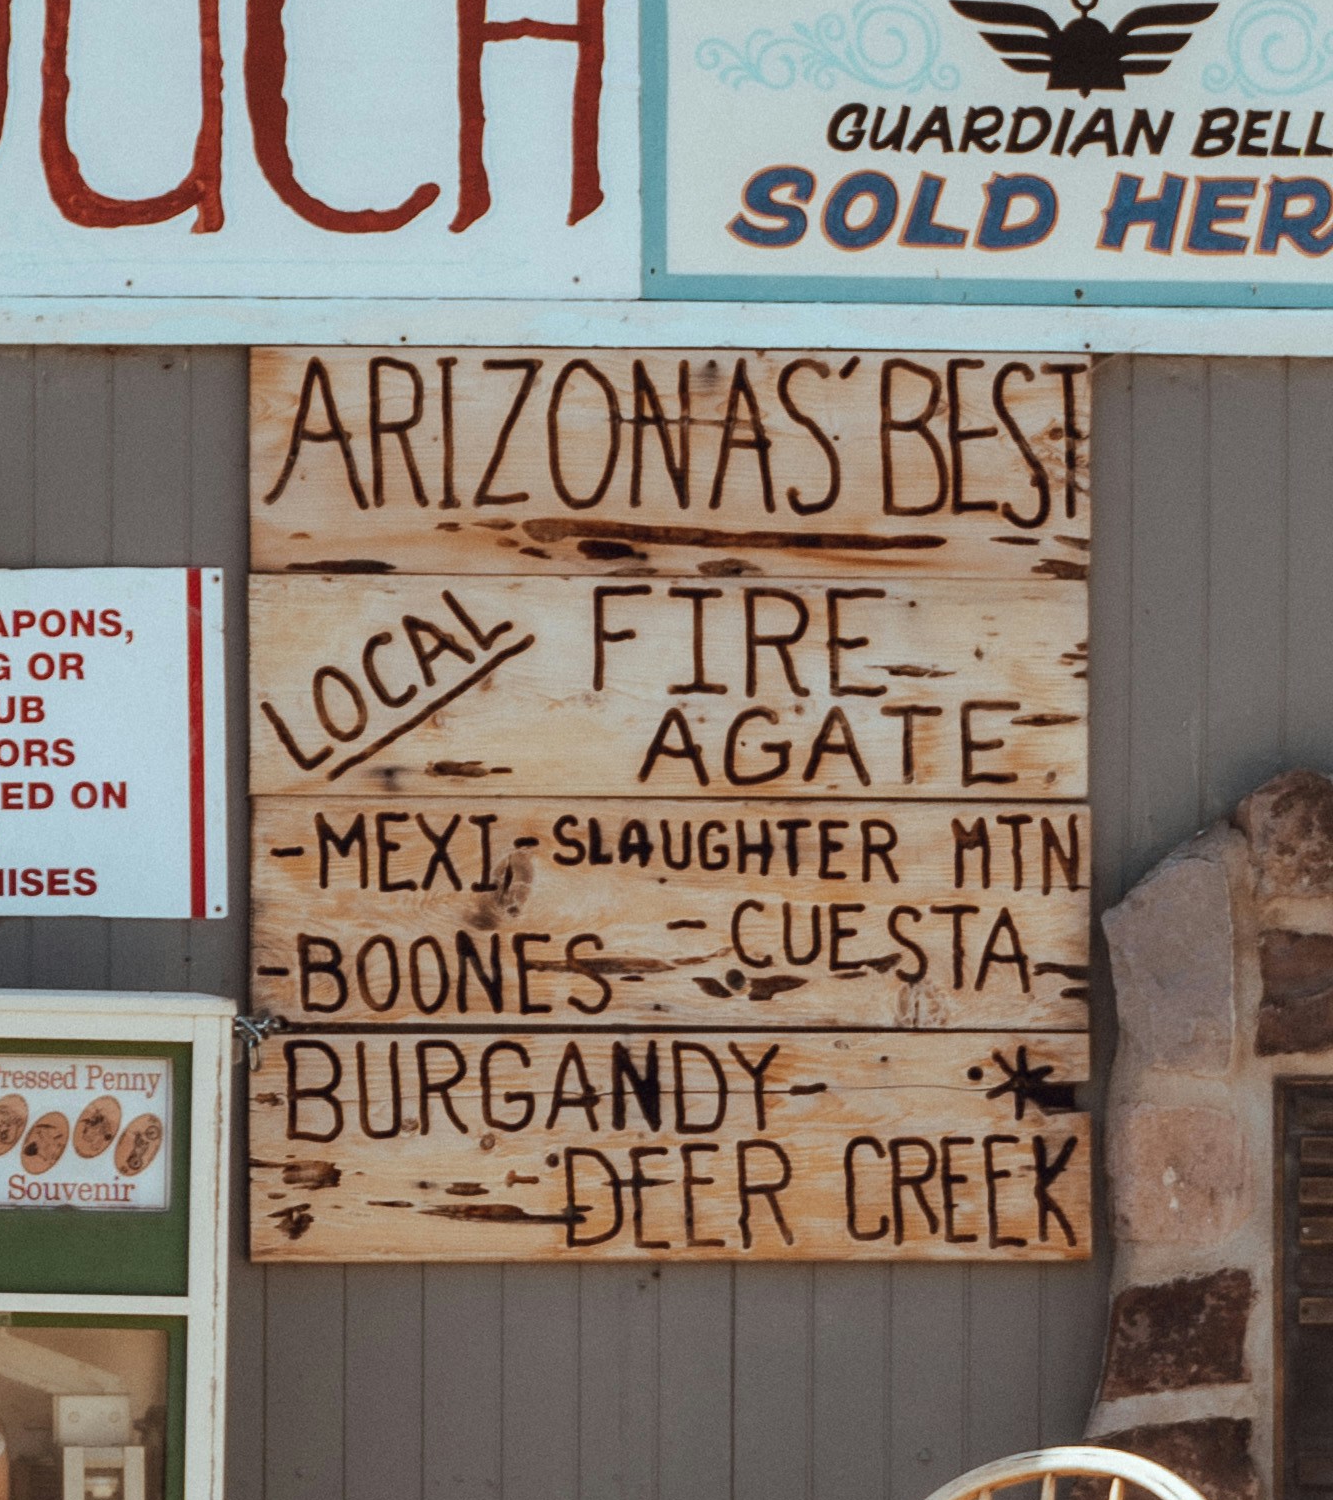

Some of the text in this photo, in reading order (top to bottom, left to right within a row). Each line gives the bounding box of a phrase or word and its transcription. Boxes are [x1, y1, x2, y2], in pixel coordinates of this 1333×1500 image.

[826, 102, 1333, 158] GUARDIAN BELL
[726, 164, 1333, 258] SOLD HER
[881, 357, 1089, 529] BEST
[27, 652, 85, 681] OR
[259, 590, 514, 772] LOCAL
[592, 584, 889, 700] FIRE
[638, 702, 1022, 788] AGATE
[71, 780, 128, 809] ON
[951, 813, 1081, 894] MTN
[85, 1065, 161, 1099] Penny
[8, 1174, 135, 1202] Souvenir
[563, 1133, 1078, 1251] DEER CREEK
